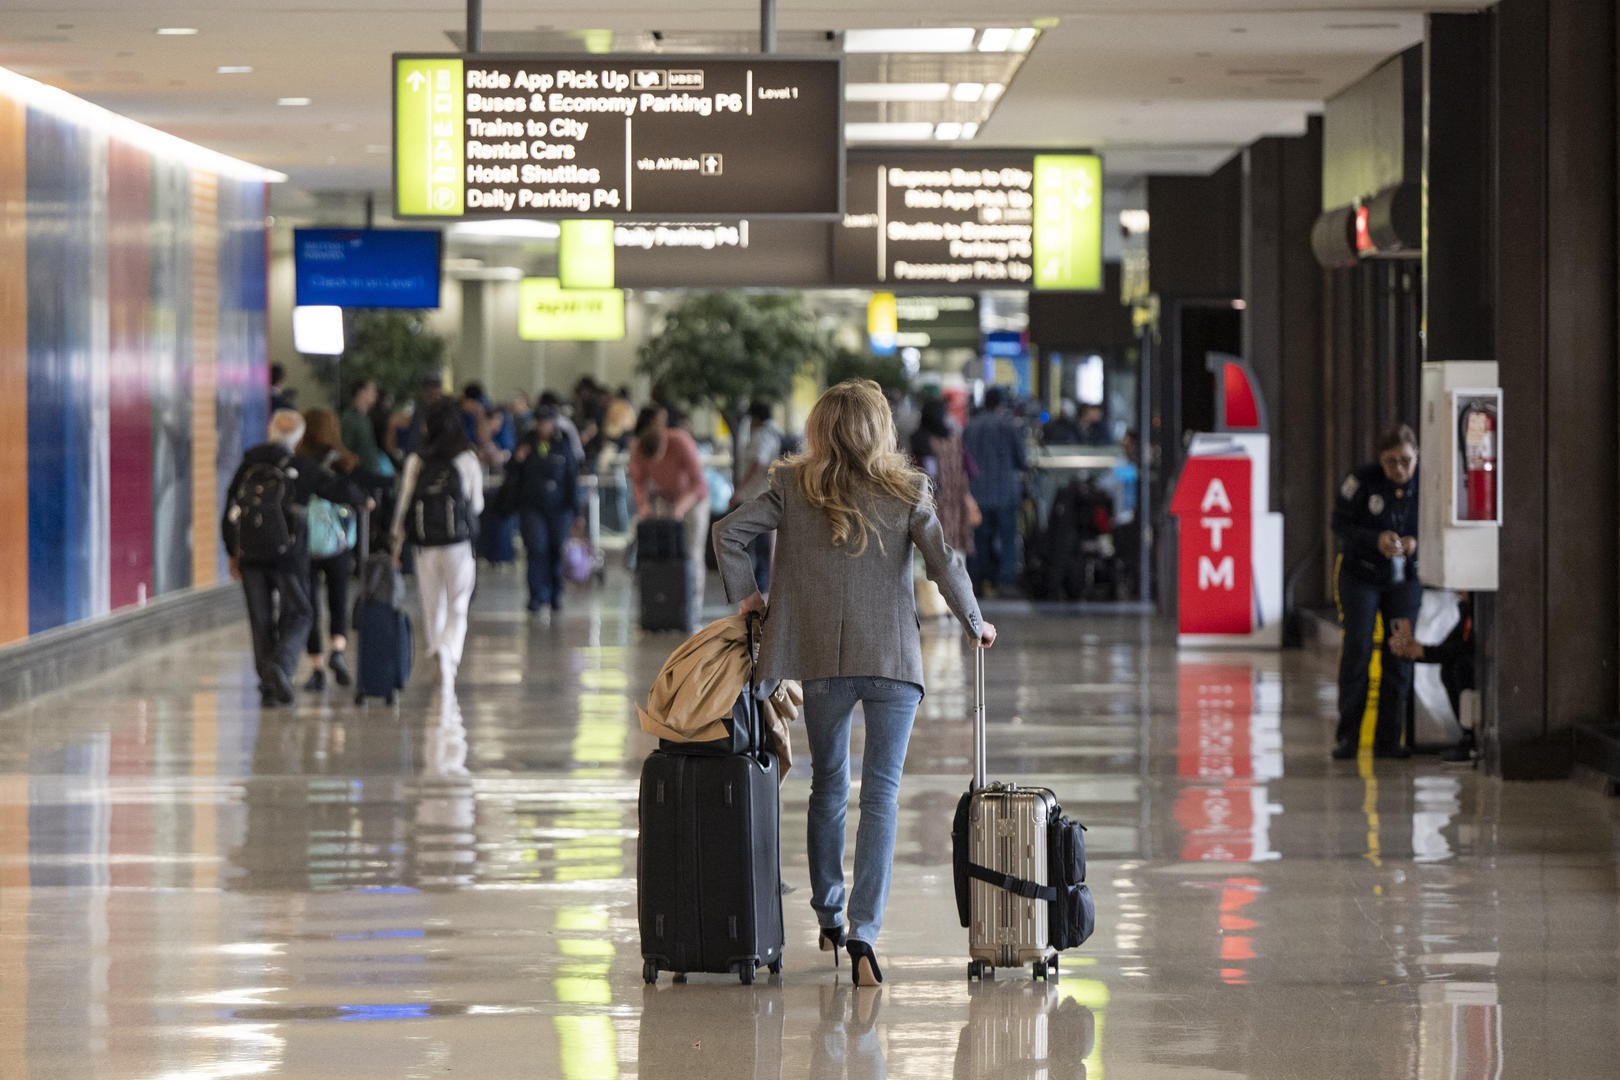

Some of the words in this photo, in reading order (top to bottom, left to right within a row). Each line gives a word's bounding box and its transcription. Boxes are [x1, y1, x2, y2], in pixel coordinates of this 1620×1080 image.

[466, 70, 511, 89] Ride
[513, 70, 554, 93] App
[556, 70, 599, 89] Pick
[601, 70, 630, 93] Up
[758, 86, 791, 99] Level
[792, 86, 799, 99] 1
[466, 93, 527, 112] Buses
[529, 93, 546, 112] &
[548, 93, 638, 116] Economy
[640, 93, 712, 116] Parking
[714, 93, 743, 112] P6
[466, 117, 525, 137] Trains
[526, 119, 548, 137] to
[550, 117, 589, 141] City
[466, 140, 529, 160] Rental
[530, 140, 576, 160] Cars
[466, 164, 519, 184] Hotel
[521, 164, 600, 184] Shuttles
[637, 157, 656, 170] via
[466, 188, 516, 212] Daily
[518, 188, 590, 212] Parking
[593, 188, 621, 208] P4
[1198, 478, 1235, 590] ATM
